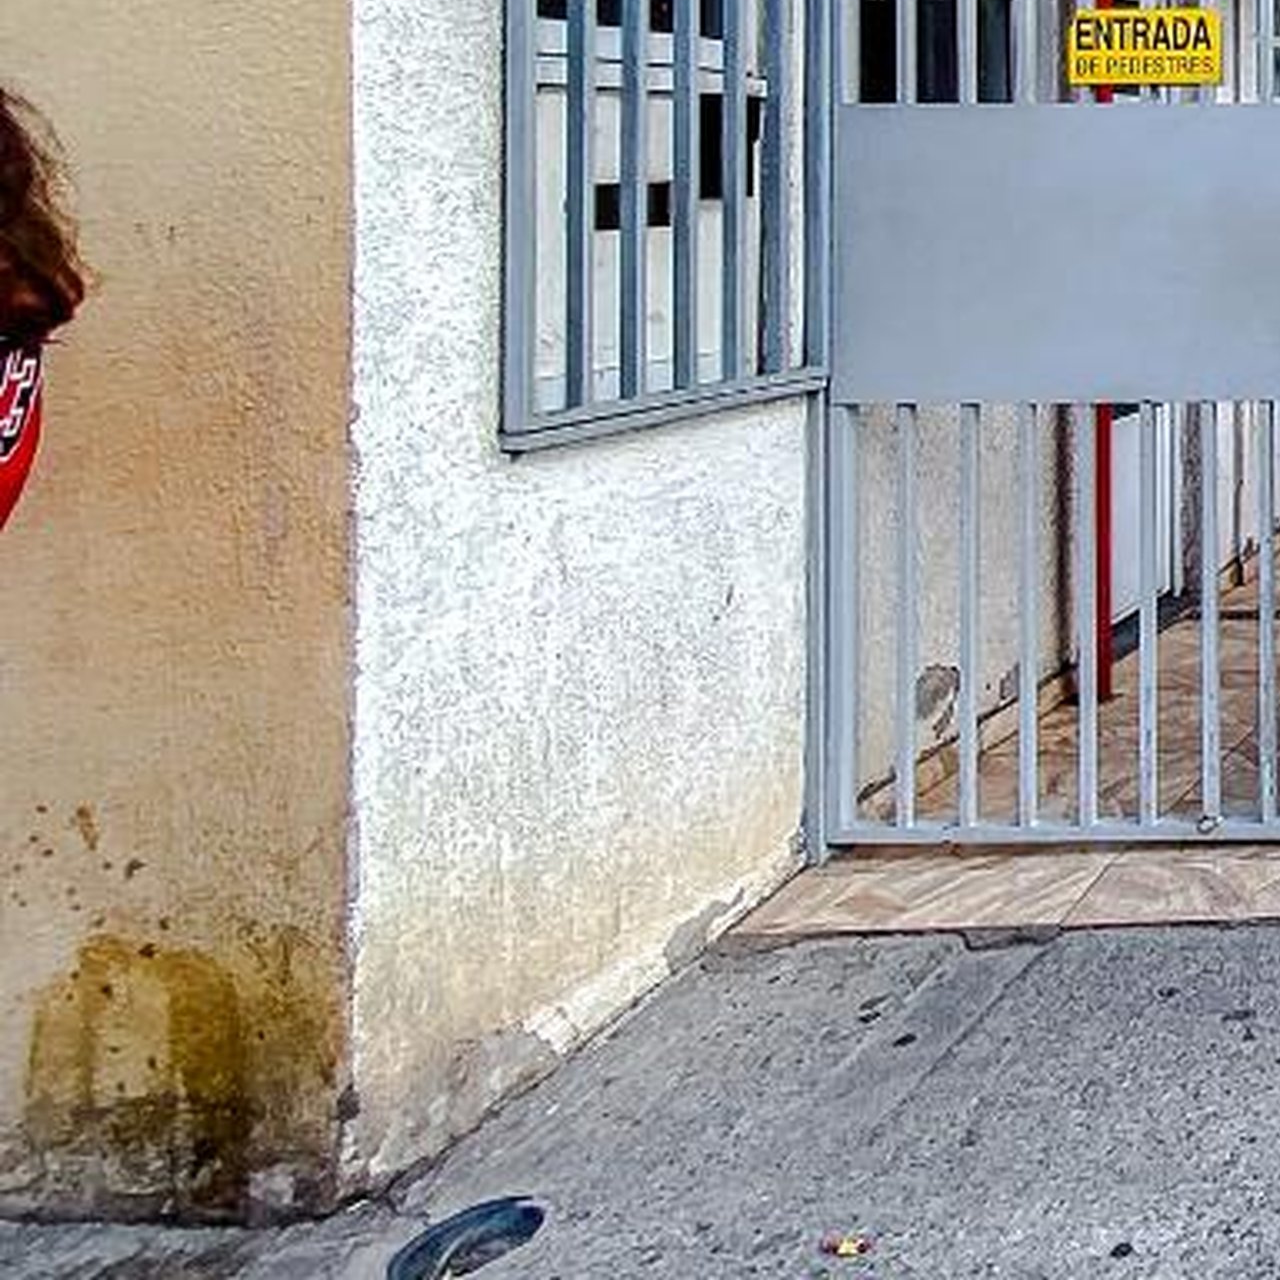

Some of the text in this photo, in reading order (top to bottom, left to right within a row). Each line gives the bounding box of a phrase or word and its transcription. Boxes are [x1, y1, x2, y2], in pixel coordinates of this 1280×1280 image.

[1075, 17, 1212, 51] ENTRADA
[1076, 55, 1214, 78] DE PEDESTRES
